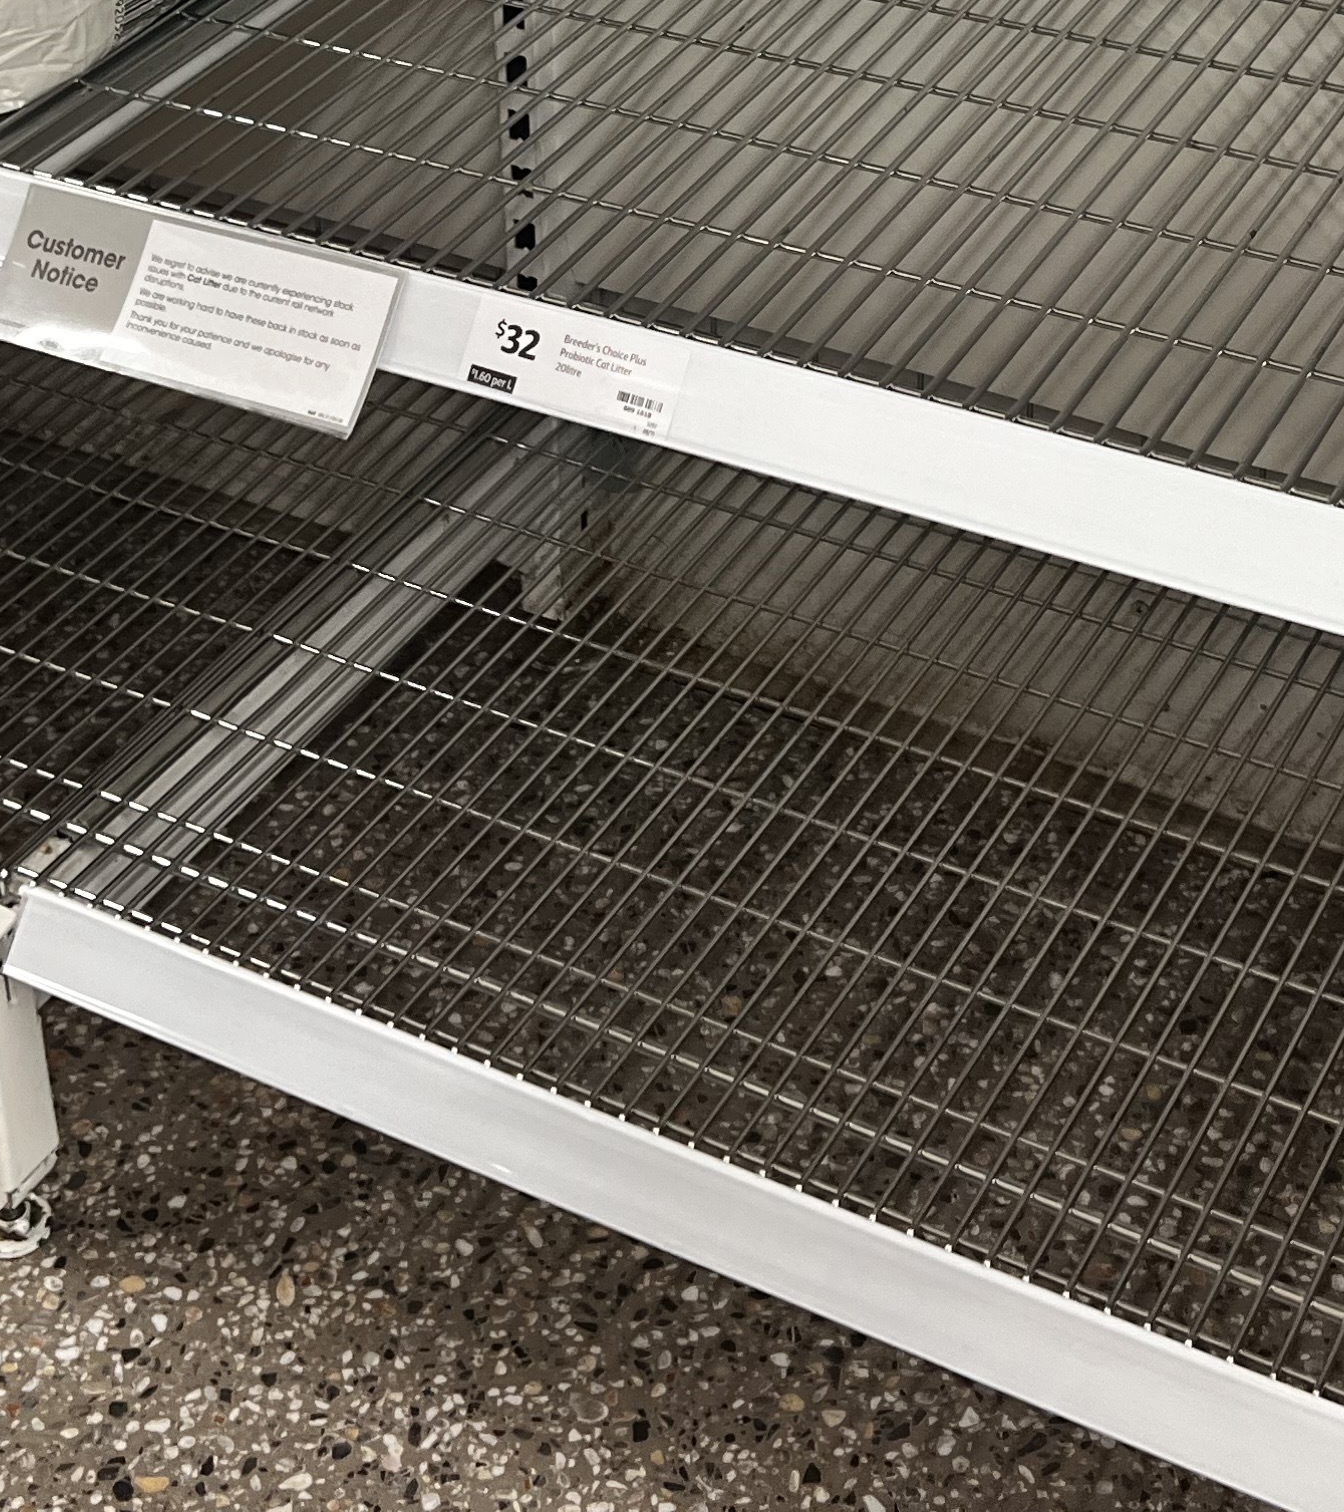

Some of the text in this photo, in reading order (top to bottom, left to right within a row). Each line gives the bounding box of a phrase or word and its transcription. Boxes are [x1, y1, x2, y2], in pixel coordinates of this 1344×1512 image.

[27, 228, 126, 271] Customer
[30, 258, 99, 293] Notice
[495, 318, 541, 362] $32
[564, 334, 647, 367] Breeder's Choice Plus
[560, 348, 632, 377] Probiotic Cat Litter
